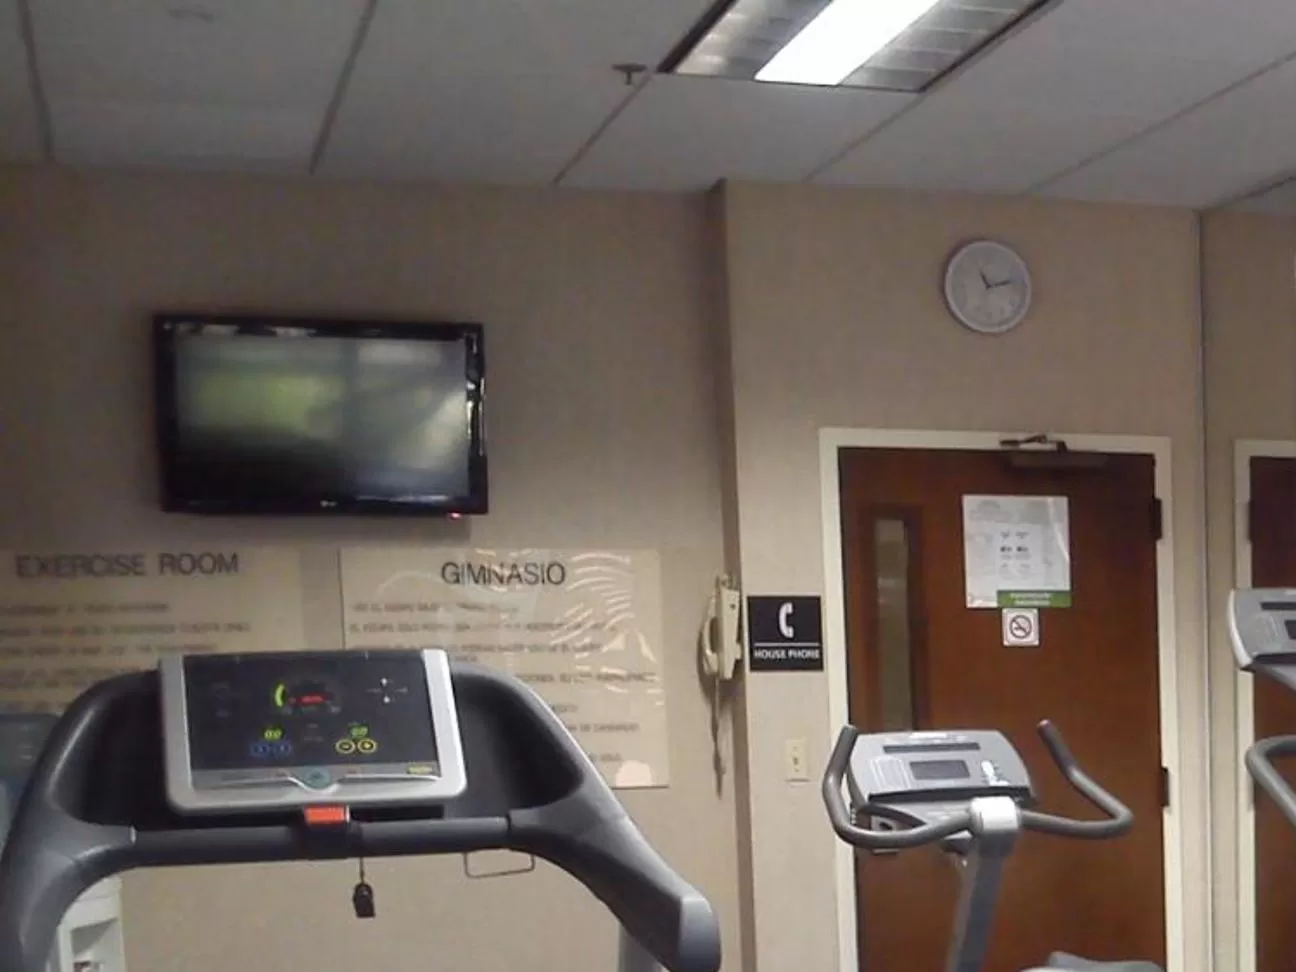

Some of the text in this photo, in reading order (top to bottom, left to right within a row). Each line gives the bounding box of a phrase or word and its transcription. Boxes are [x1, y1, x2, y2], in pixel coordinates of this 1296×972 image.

[15, 552, 238, 579] EXERCISE ROOM
[441, 560, 567, 586] GIMNASIO
[754, 648, 820, 660] HOUSE PHONE
